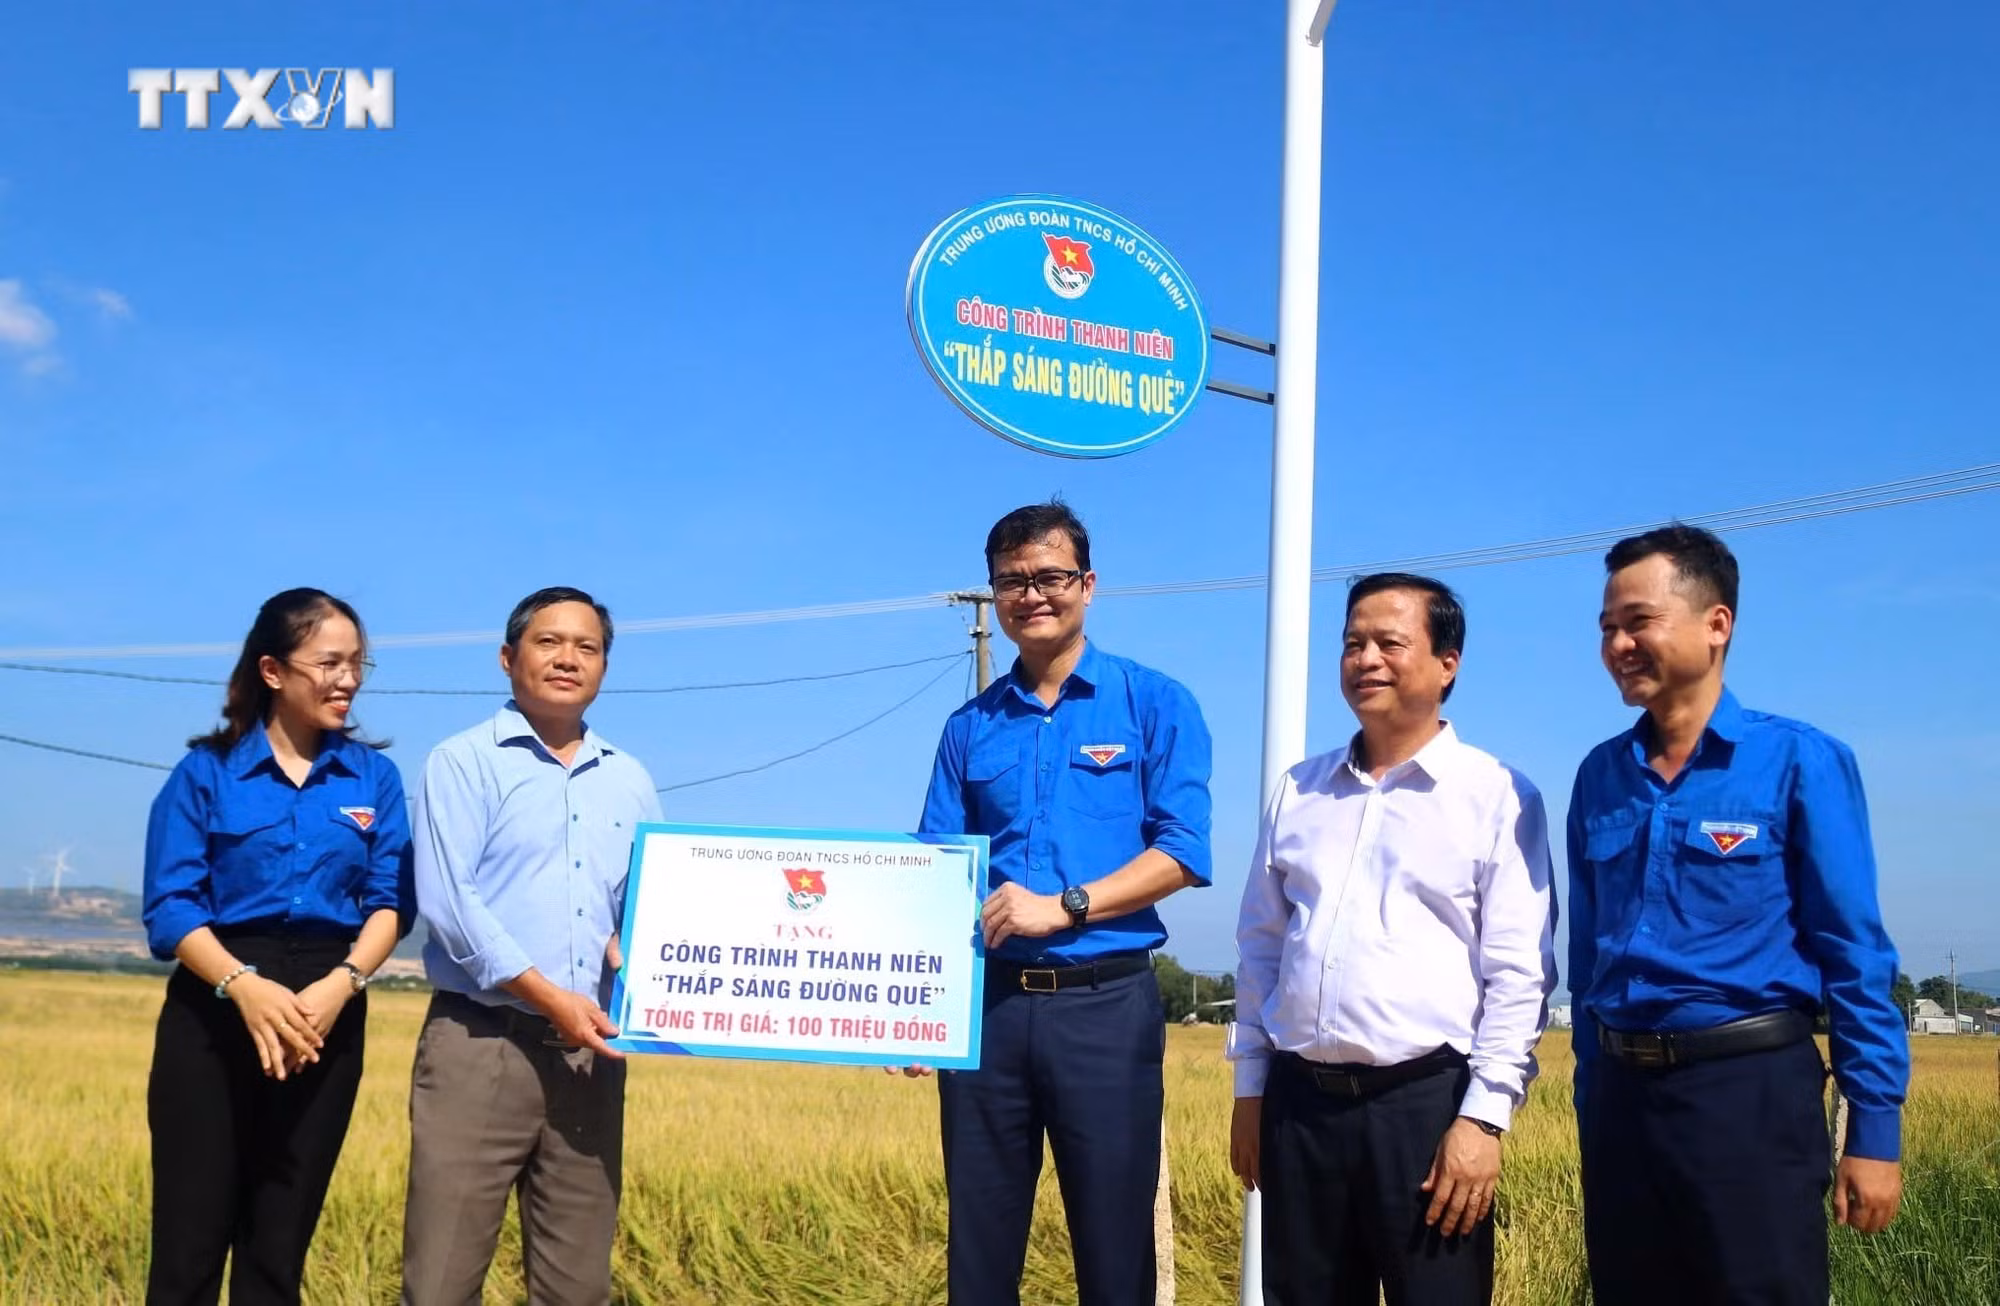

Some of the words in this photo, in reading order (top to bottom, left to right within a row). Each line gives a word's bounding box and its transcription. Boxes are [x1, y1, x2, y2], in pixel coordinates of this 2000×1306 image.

[939, 225, 985, 266] TRUNG
[983, 212, 1026, 234] ƯƠNG
[1029, 209, 1070, 228] ĐOÀN
[1074, 217, 1112, 242] TNCS
[1136, 250, 1163, 275] CHÍ
[1158, 272, 1188, 311] MINH
[957, 296, 1008, 332] CÔNG
[1012, 306, 1067, 342] TRÌNH
[1071, 319, 1130, 353] THANH
[1134, 328, 1174, 361] NIÊN
[1012, 345, 1062, 397] SÁNG
[1068, 357, 1133, 408] ĐƯỜNG
[690, 847, 733, 860] TRUNG
[737, 848, 773, 861] ƯƠNG
[816, 852, 849, 864] TNCS
[899, 856, 932, 867] MINH
[660, 939, 722, 964] CÔNG
[731, 943, 798, 967] TRÌNH
[806, 950, 882, 971] THANH
[890, 950, 943, 974] NIÊN
[731, 973, 791, 999] SÁNG
[799, 978, 878, 1003] ĐƯỜNG
[702, 1011, 733, 1036] TRỊ
[740, 1009, 779, 1034] GIÁ:
[788, 1016, 823, 1036] 100
[830, 1014, 886, 1043] TRIỆU
